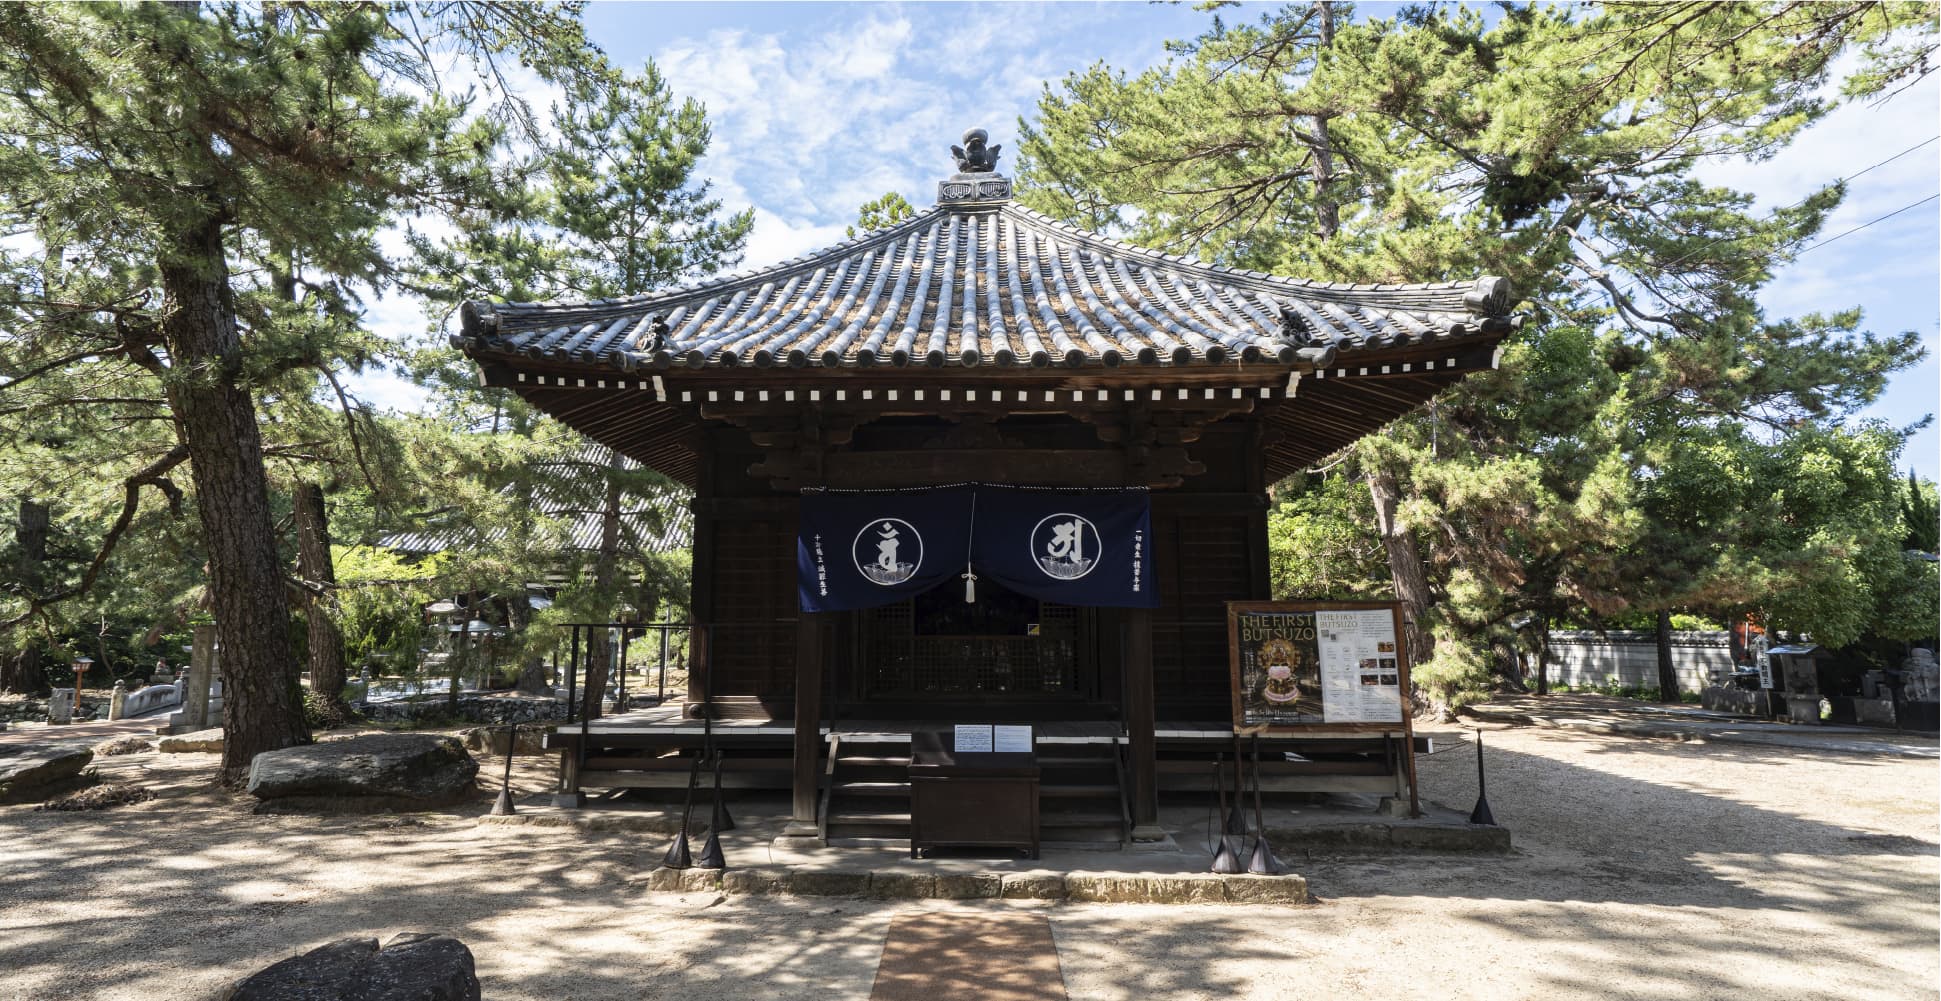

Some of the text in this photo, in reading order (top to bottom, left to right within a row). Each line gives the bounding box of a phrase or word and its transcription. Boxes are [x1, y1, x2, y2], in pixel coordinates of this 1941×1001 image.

[1240, 614, 1313, 628] THE FIRST
[1320, 620, 1358, 628] BUTSUZO
[1243, 627, 1315, 641] BUTSUZO
